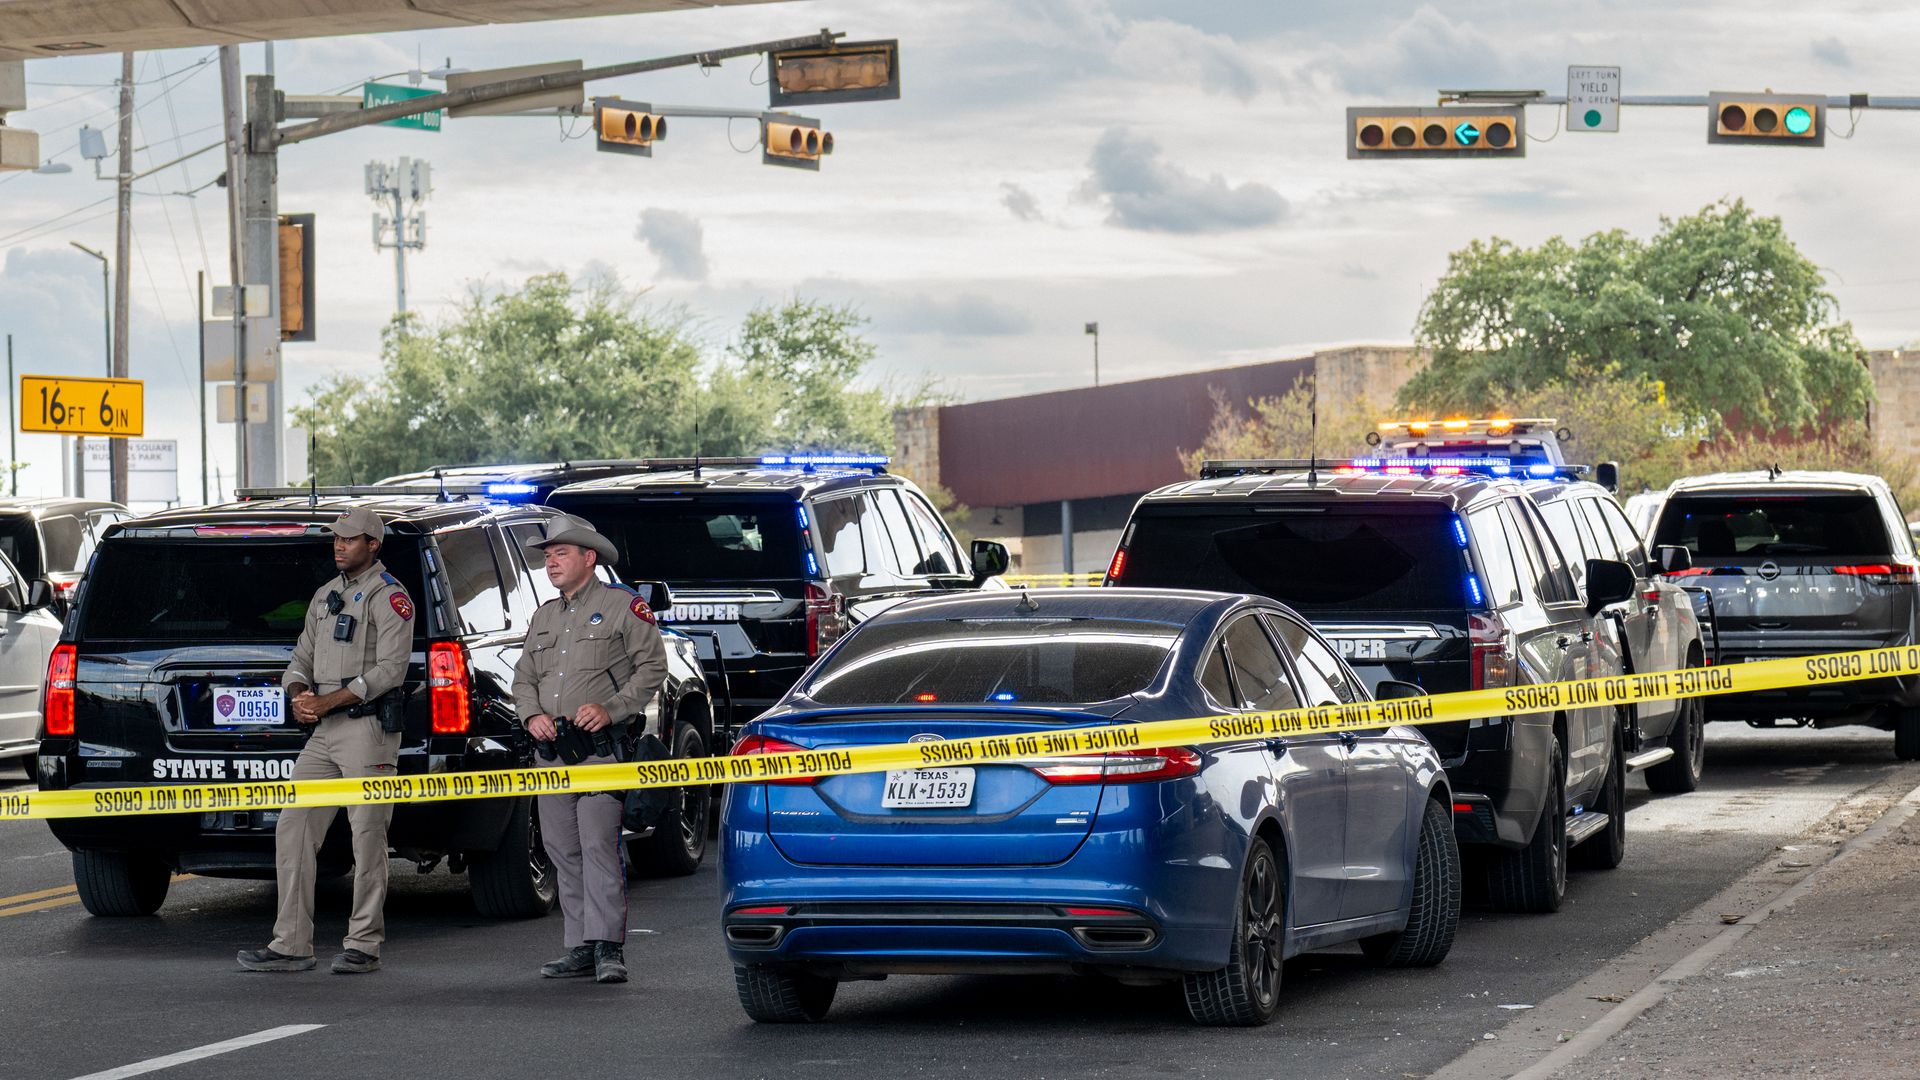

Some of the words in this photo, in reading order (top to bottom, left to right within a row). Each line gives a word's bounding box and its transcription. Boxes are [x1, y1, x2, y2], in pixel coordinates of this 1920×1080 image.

[1570, 71, 1591, 80] LEFT
[1596, 71, 1618, 80] TURN
[1580, 82, 1609, 93] YIELD
[1572, 95, 1583, 104] ON
[1588, 95, 1615, 104] GREEN
[136, 444, 174, 452] SQUARE
[138, 453, 162, 461] PARK
[1806, 654, 1862, 681] CROSS
[1868, 650, 1902, 675] NOT
[1604, 678, 1627, 701] DO
[1632, 674, 1669, 699] LINE
[1674, 667, 1733, 695] POLICE
[236, 690, 264, 698] TEXAS
[1505, 685, 1560, 711] CROSS
[1566, 681, 1599, 705] NOT
[238, 700, 279, 717] 09550
[1307, 708, 1330, 728] DO
[1334, 704, 1371, 725] LINE
[1375, 698, 1433, 722] POLICE
[1209, 715, 1264, 737] CROSS
[1271, 711, 1302, 732] NOT
[980, 738, 1011, 760] NOT
[1015, 735, 1039, 757] DO
[1042, 733, 1079, 754] LINE
[1083, 726, 1140, 750] POLICE
[795, 751, 852, 773] POLICE
[919, 741, 974, 765] CROSS
[152, 758, 226, 779] STATE
[637, 762, 690, 785] CROSS
[695, 760, 726, 781] NOT
[730, 758, 753, 779] DO
[756, 755, 792, 777] LINE
[914, 771, 949, 780] TEXAS
[361, 778, 413, 801] CROSS
[417, 776, 448, 798] NOT
[452, 775, 474, 797] DO
[477, 773, 513, 795] LINE
[516, 769, 571, 792] POLICE
[94, 790, 143, 813] CROSS
[147, 789, 177, 811] NOT
[182, 788, 203, 810] DO
[206, 786, 240, 808] LINE
[244, 784, 297, 806] POLICE
